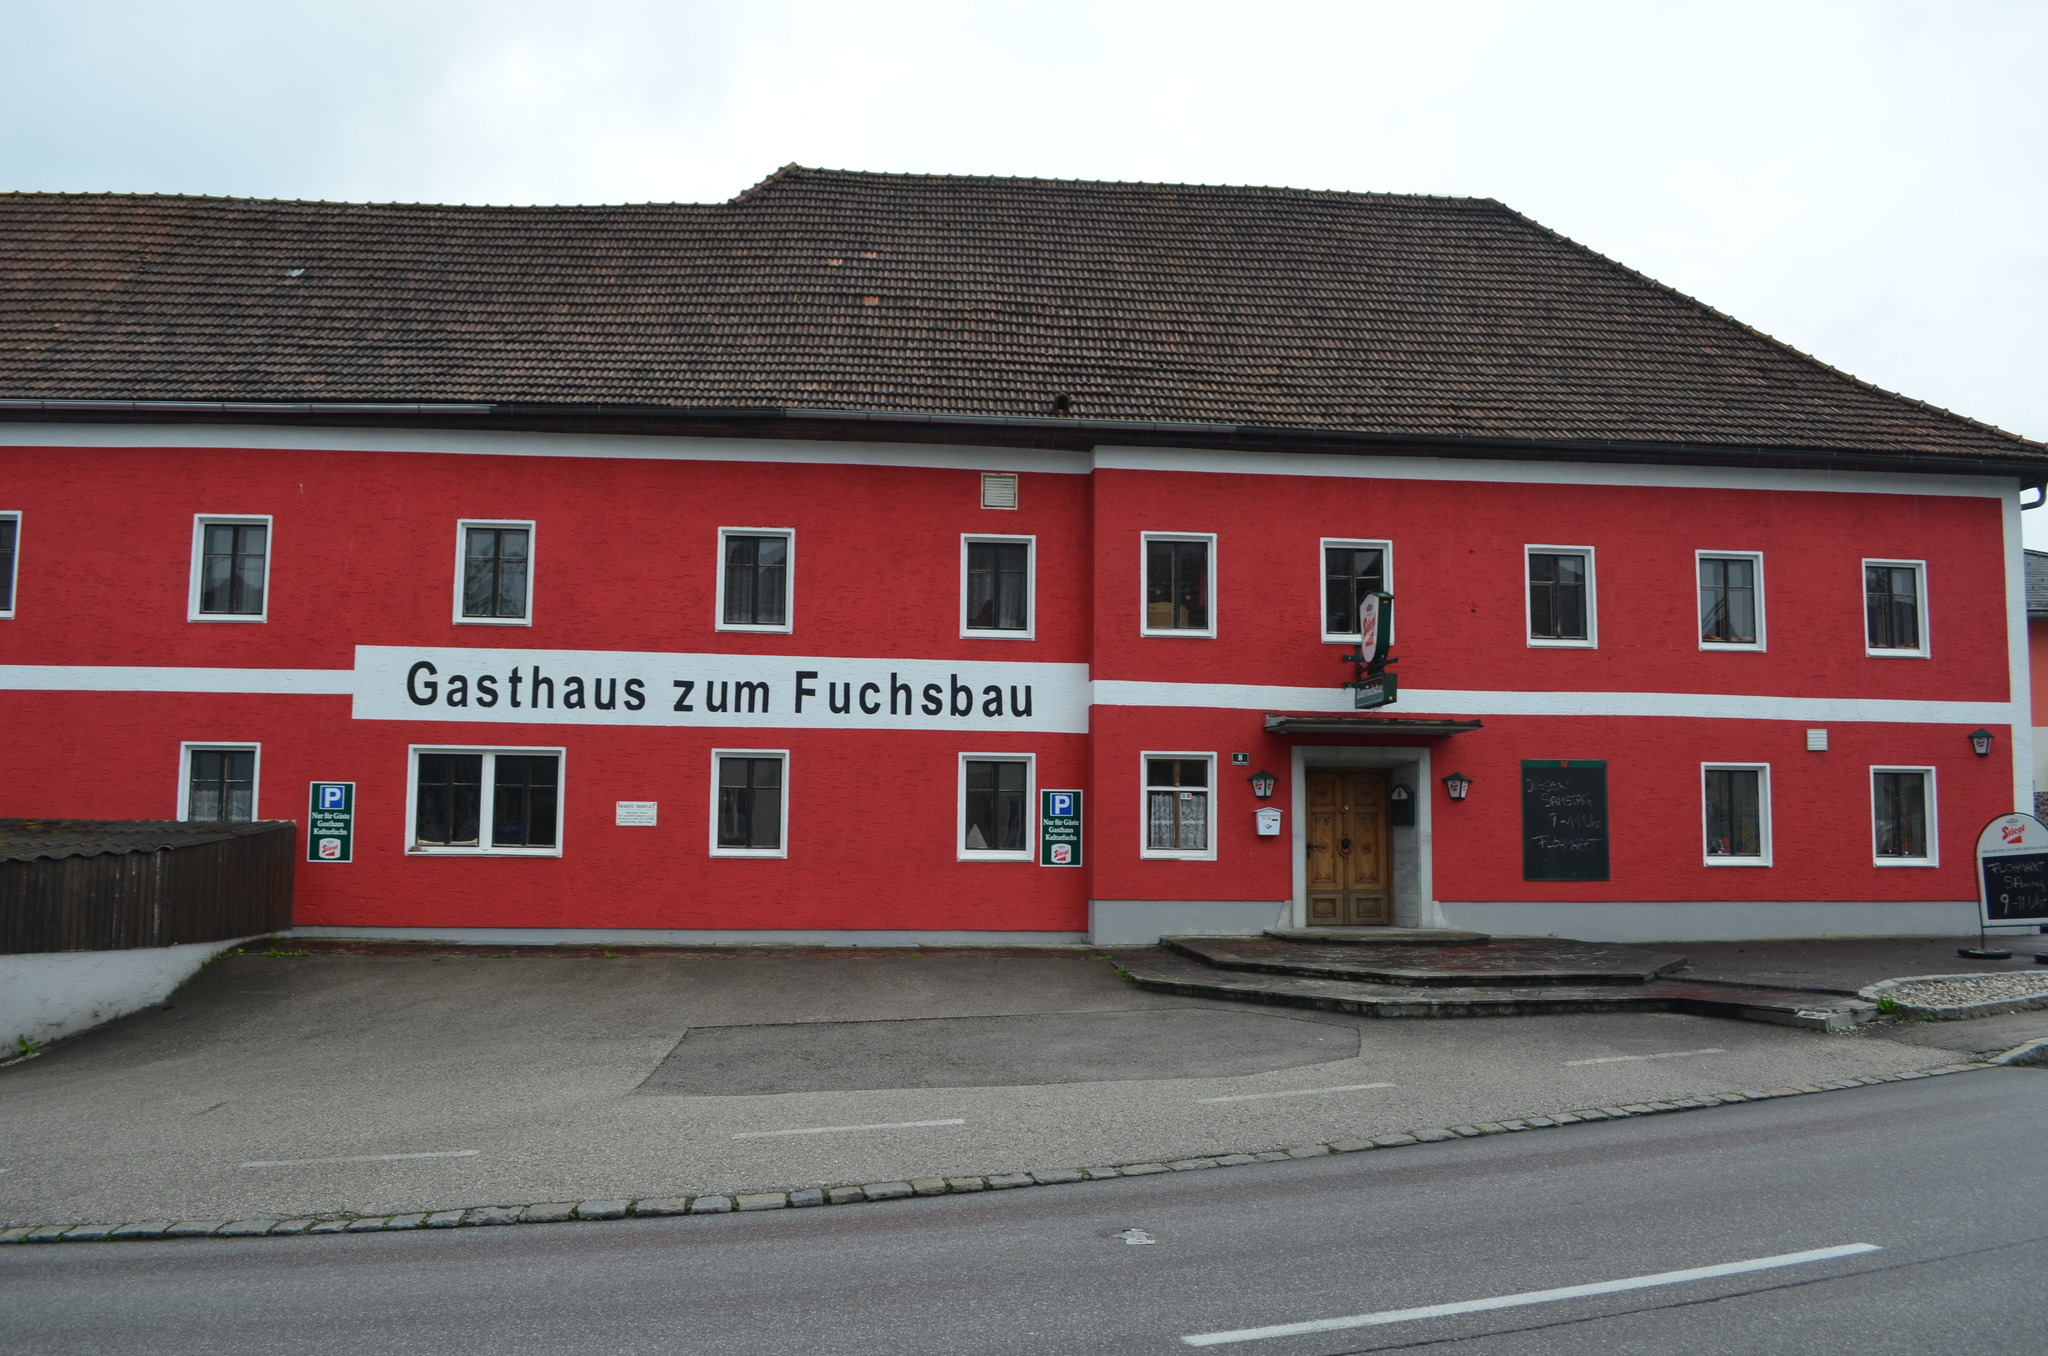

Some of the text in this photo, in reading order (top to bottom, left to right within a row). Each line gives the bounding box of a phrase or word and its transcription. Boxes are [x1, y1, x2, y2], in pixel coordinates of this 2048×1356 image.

[406, 660, 1032, 718] Gasthaus zum Fuchsbau
[324, 787, 341, 808] P
[1055, 795, 1070, 815] P
[1541, 793, 1592, 808] SAMSTAG
[333, 812, 350, 820] Gäste
[2002, 824, 2025, 841] Stiegl
